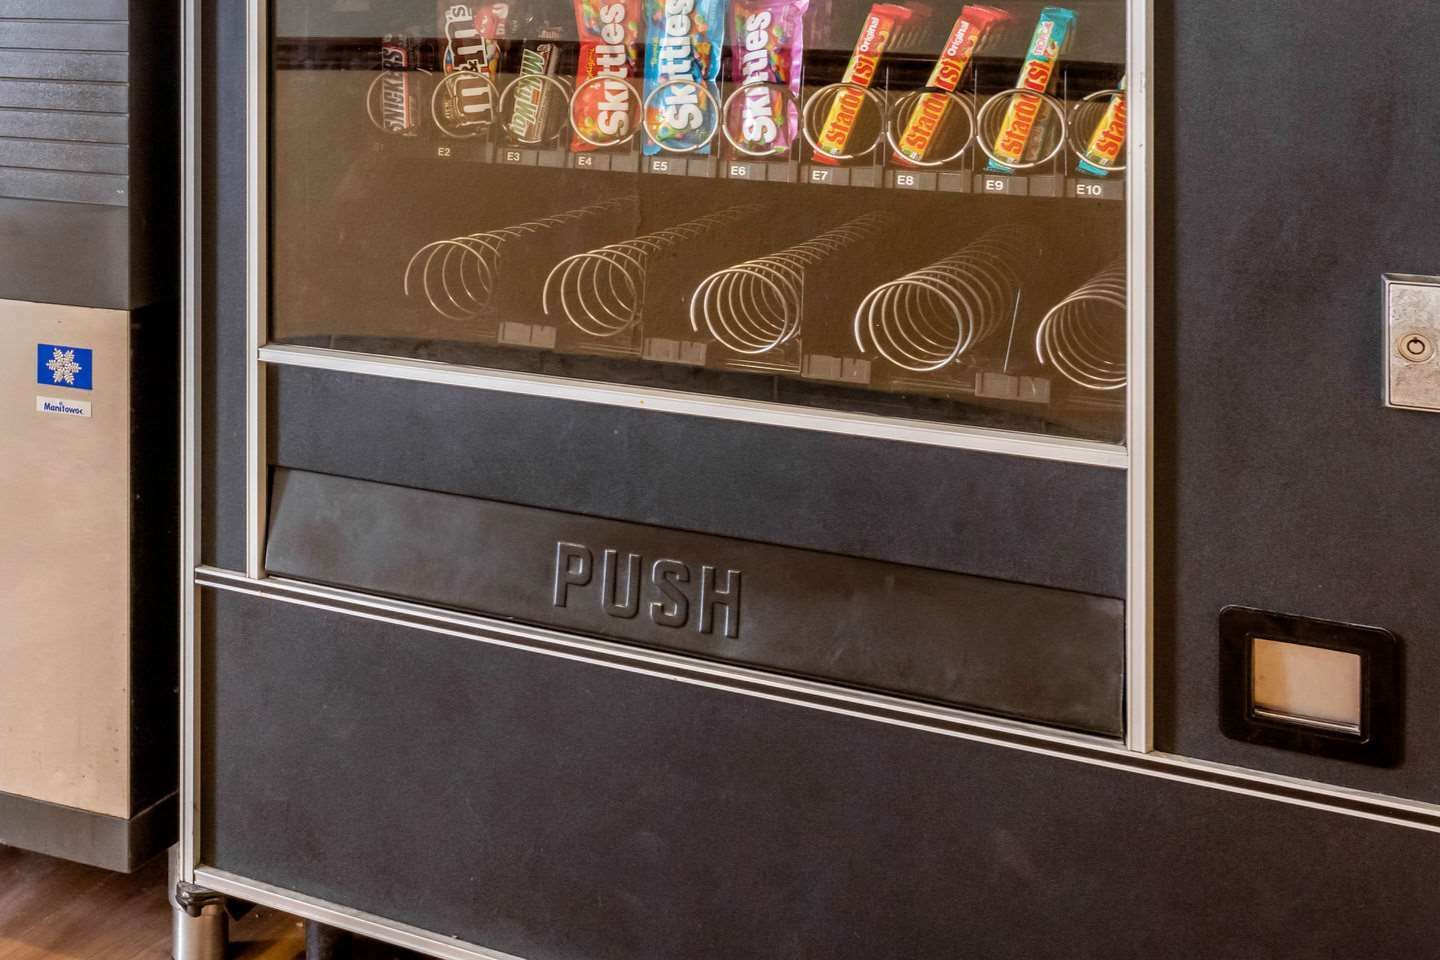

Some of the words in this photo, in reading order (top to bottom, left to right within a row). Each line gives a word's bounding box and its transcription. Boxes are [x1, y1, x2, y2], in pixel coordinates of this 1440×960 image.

[860, 16, 880, 53] Original
[946, 20, 971, 58] Original
[438, 148, 451, 157] E2
[507, 152, 520, 161] E3
[578, 157, 592, 167] E4
[653, 161, 668, 171] E5
[731, 166, 746, 176] E6
[812, 171, 828, 181] E7
[897, 175, 914, 186] E8
[986, 179, 1004, 191] E9
[1076, 184, 1102, 195] E10
[43, 402, 84, 415] Manitowoc
[553, 541, 742, 639] PUSH
